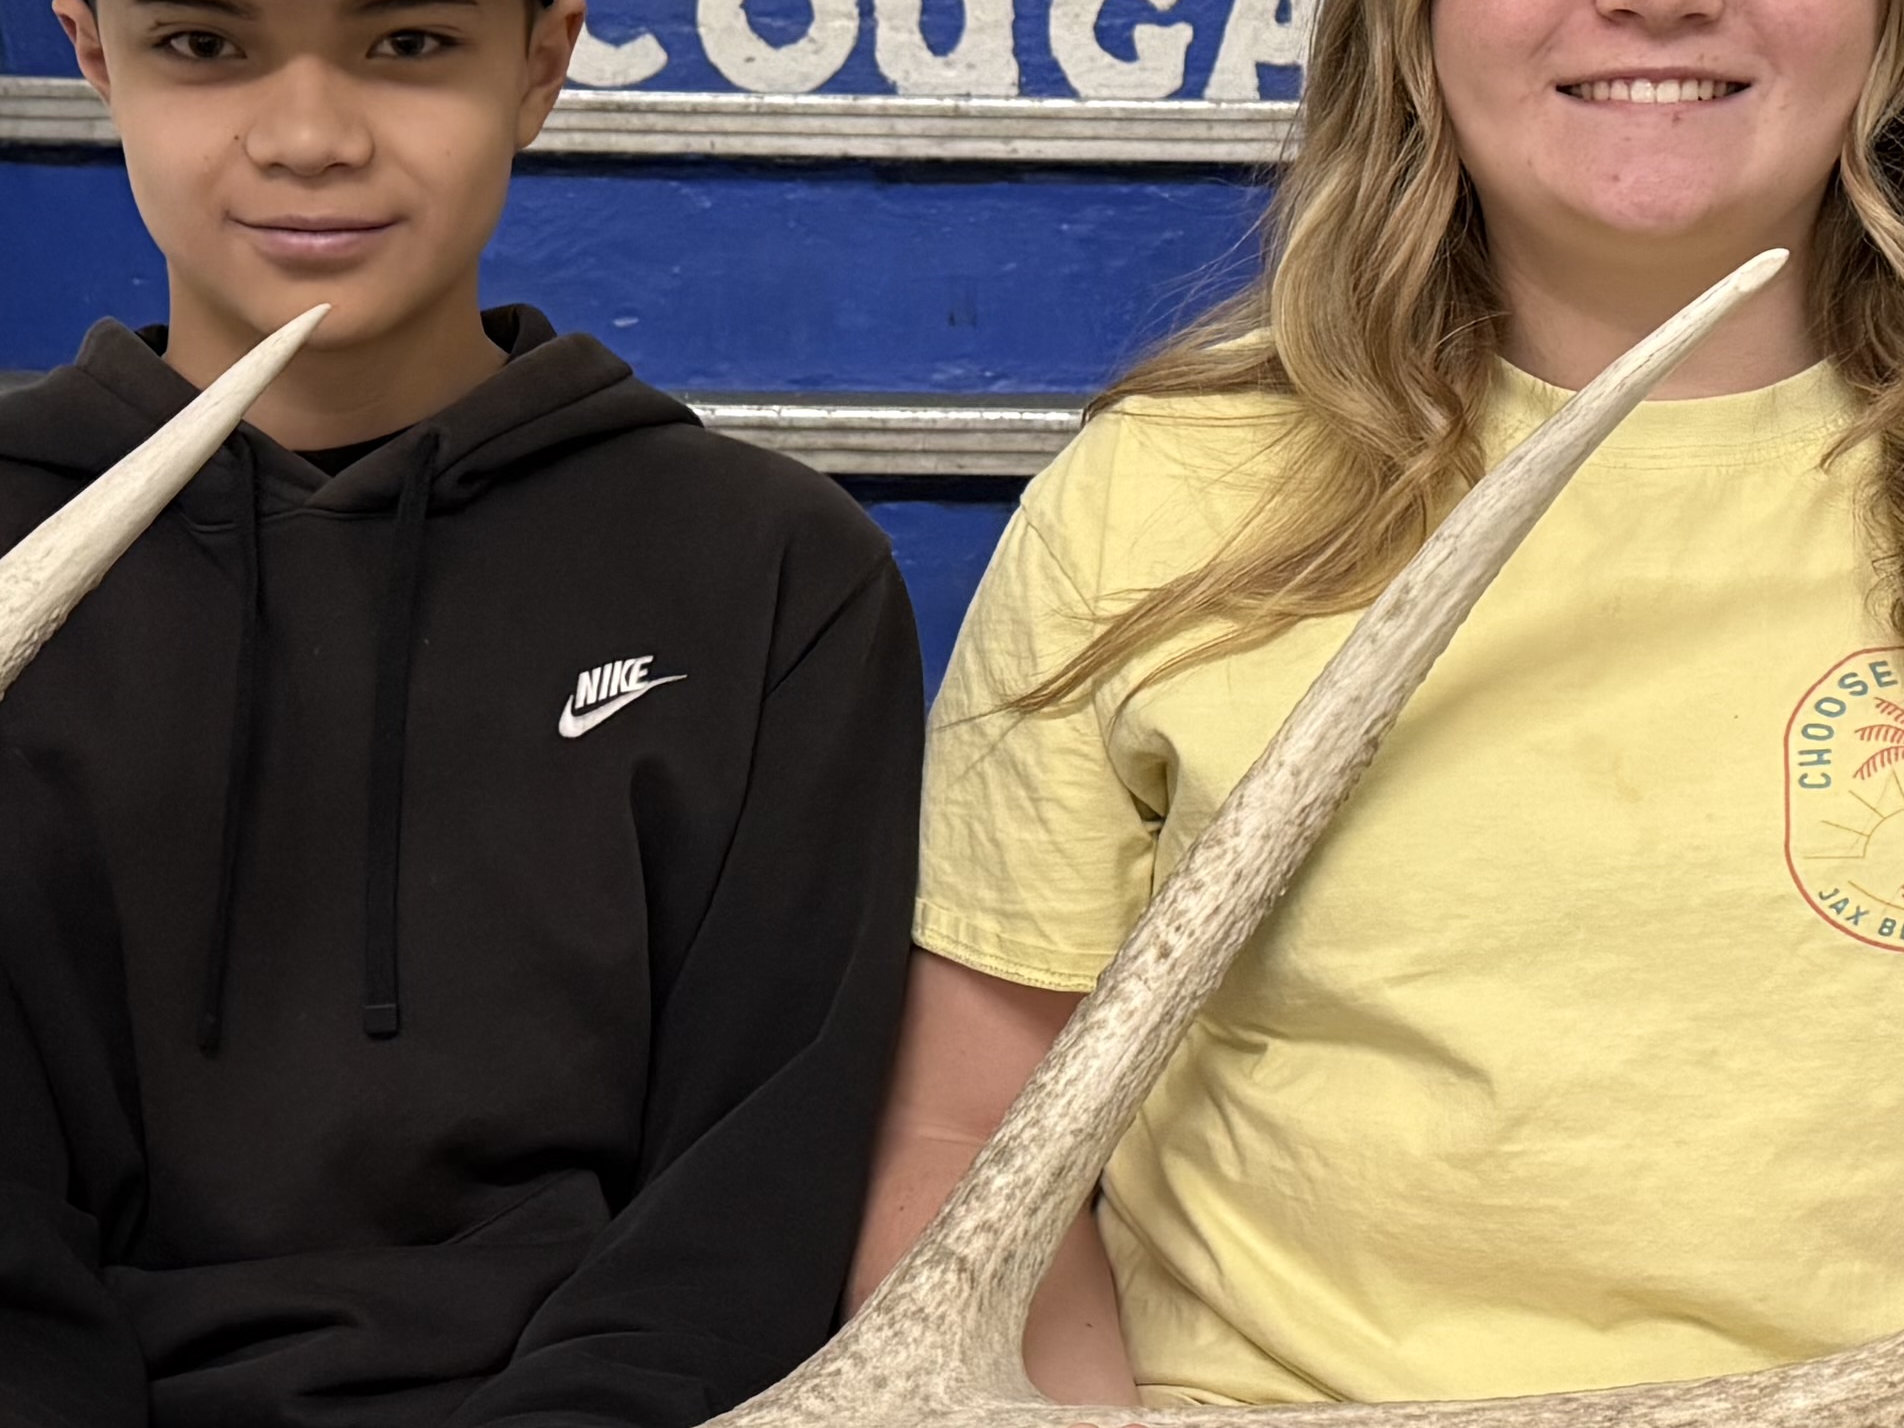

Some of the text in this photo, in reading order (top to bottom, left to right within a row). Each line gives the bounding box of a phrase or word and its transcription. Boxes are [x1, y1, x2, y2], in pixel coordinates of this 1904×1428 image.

[574, 655, 654, 709] NIKE
[1797, 660, 1899, 790] CHOOSE
[1818, 885, 1870, 927] JAX
